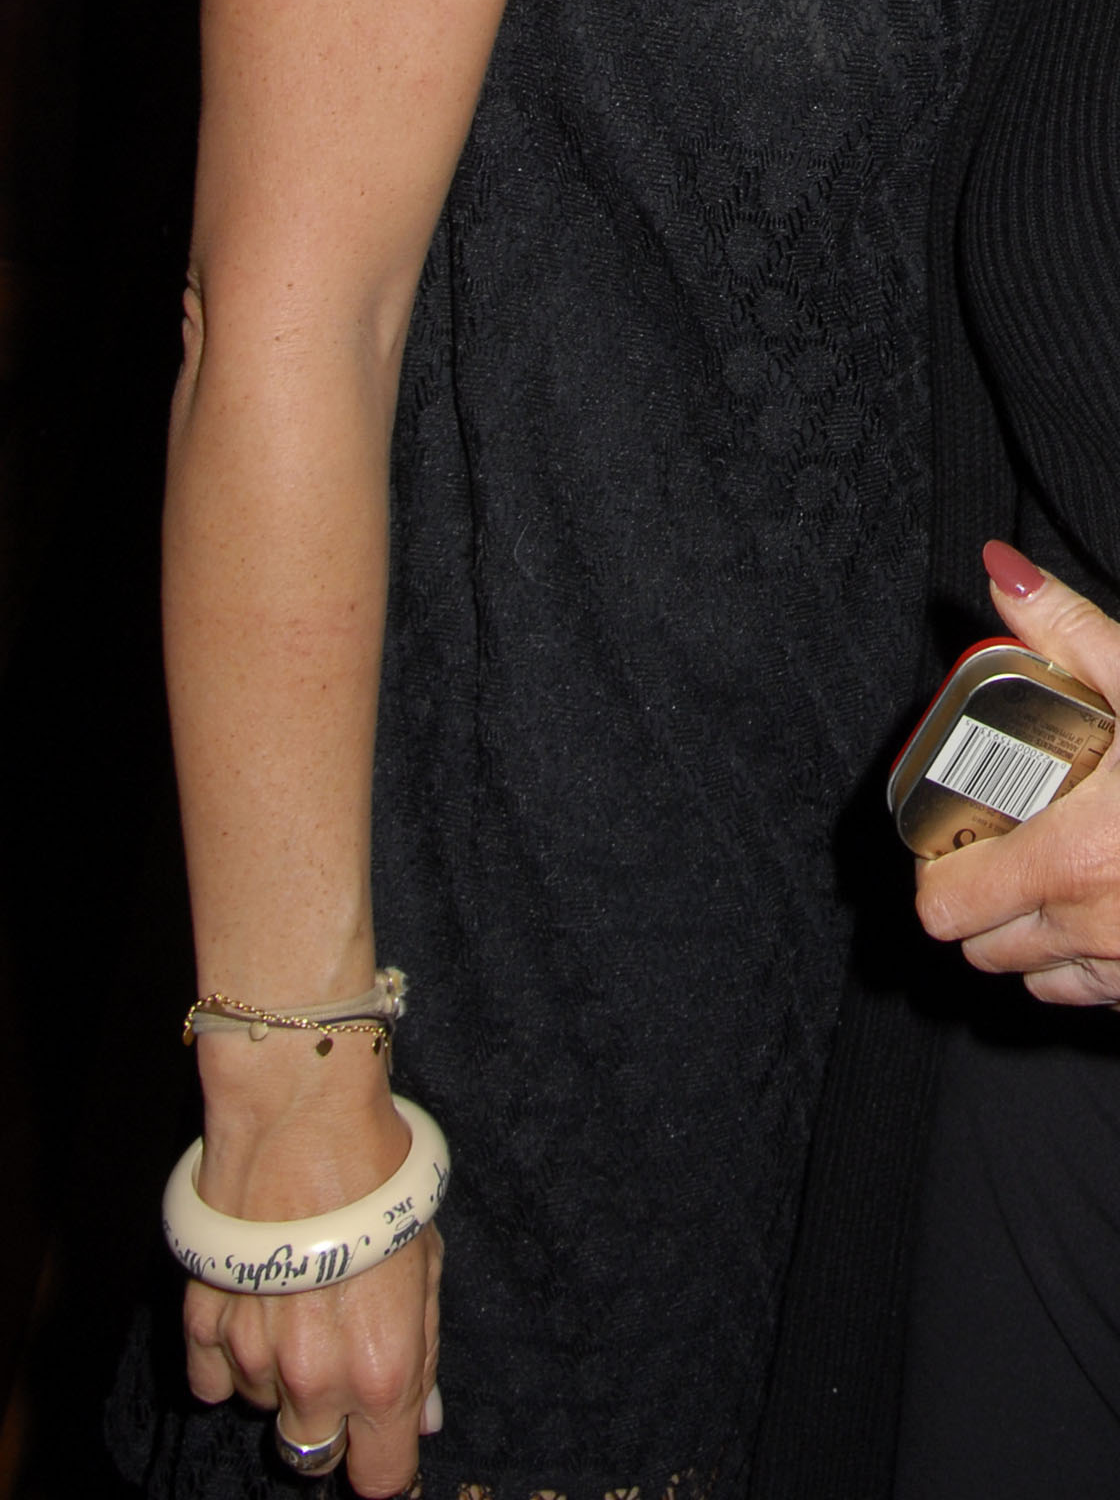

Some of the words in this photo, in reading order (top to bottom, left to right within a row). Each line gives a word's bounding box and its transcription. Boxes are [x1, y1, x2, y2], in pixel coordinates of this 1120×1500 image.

[1015, 743, 1050, 763] 22000
[383, 1196, 415, 1225] JKC
[225, 1244, 309, 1291] right,
[316, 1234, 371, 1285] All
